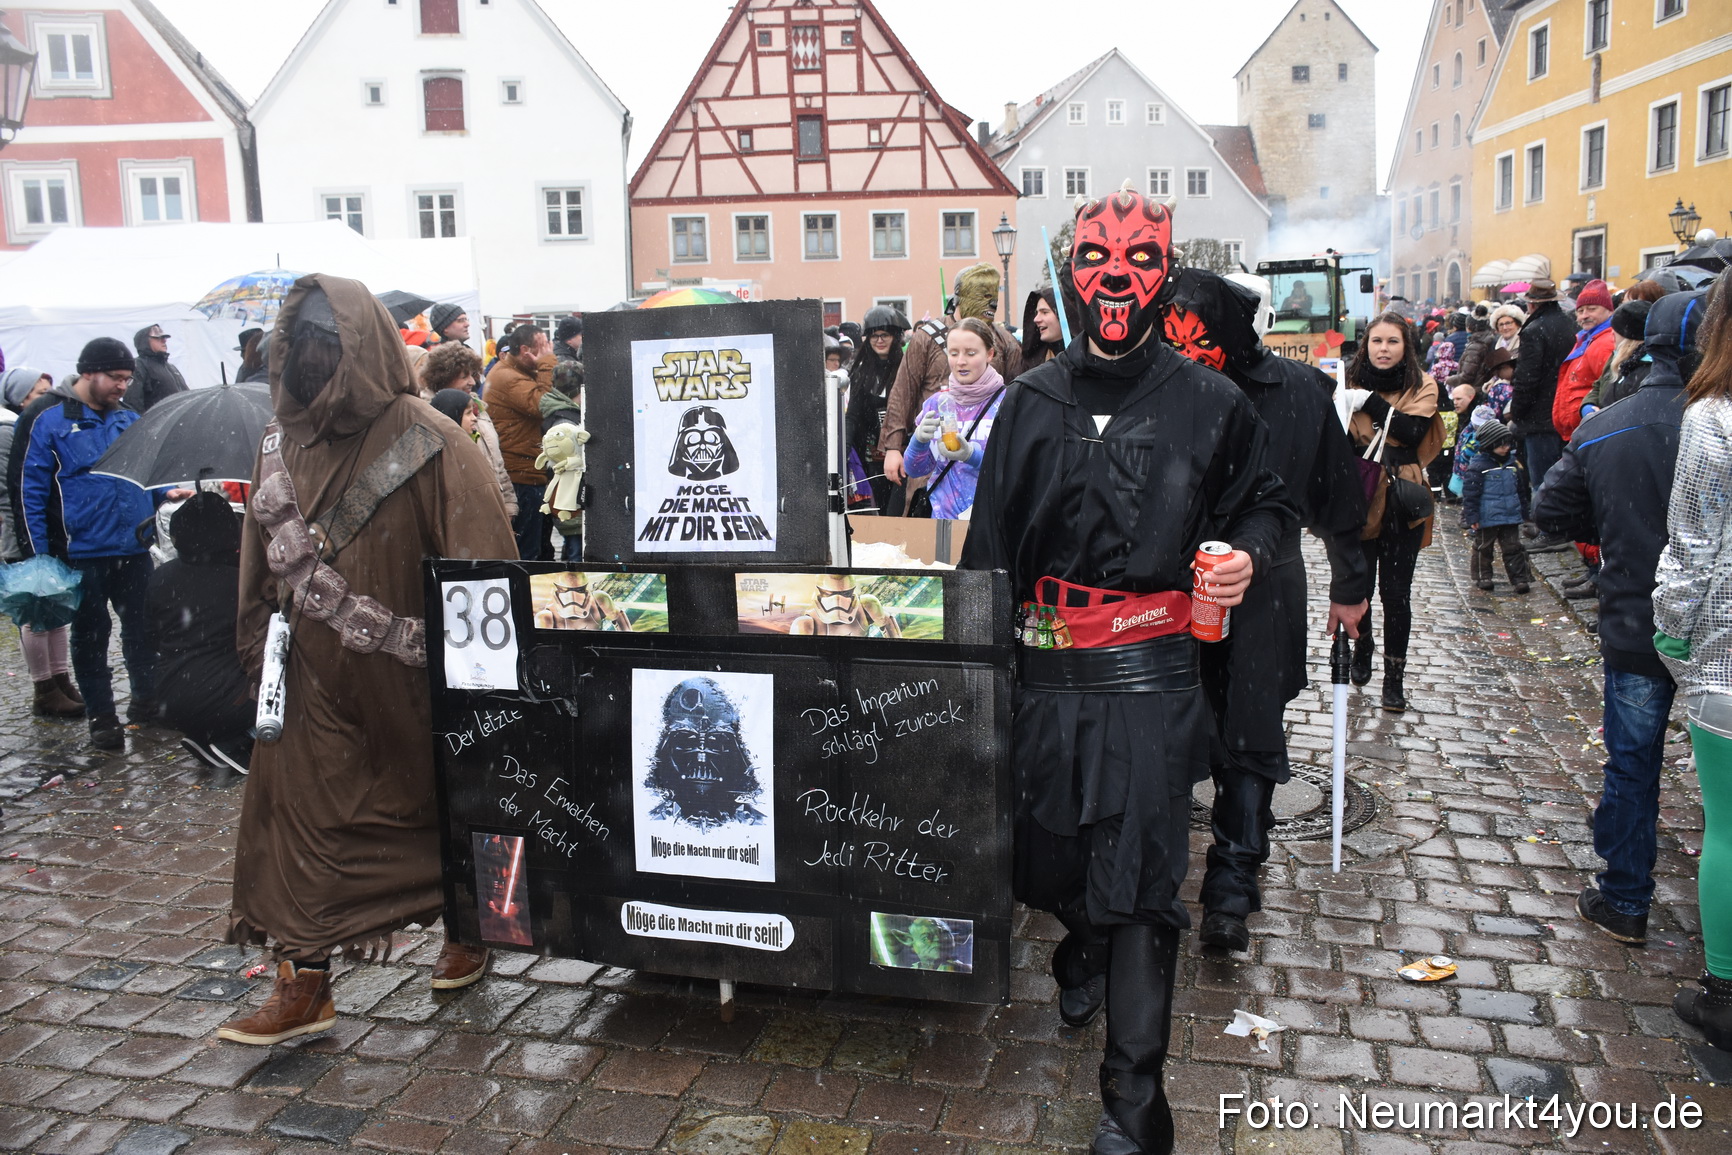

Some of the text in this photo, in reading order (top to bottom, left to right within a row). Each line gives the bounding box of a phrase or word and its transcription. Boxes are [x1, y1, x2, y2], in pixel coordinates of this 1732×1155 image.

[652, 349, 751, 377] STAR
[654, 373, 751, 402] WARS
[658, 497, 752, 513] DIE MACHT
[677, 483, 732, 496] MÖGE
[637, 515, 773, 541] MIT DIR SEIN
[444, 585, 511, 651] 38
[1111, 606, 1168, 633] Berentzen
[801, 679, 939, 735] Das Imperium
[445, 730, 475, 756] Der
[821, 699, 964, 764] schlägt zurück
[499, 755, 610, 841] Das Erwachen
[796, 788, 961, 838] Rückkehr der
[499, 792, 579, 858] der Macht
[651, 835, 759, 866] Möge die Macht mir dir sein!
[804, 840, 949, 883] Jedi Ritter
[626, 904, 784, 948] Möge die Macht mit dir sein!
